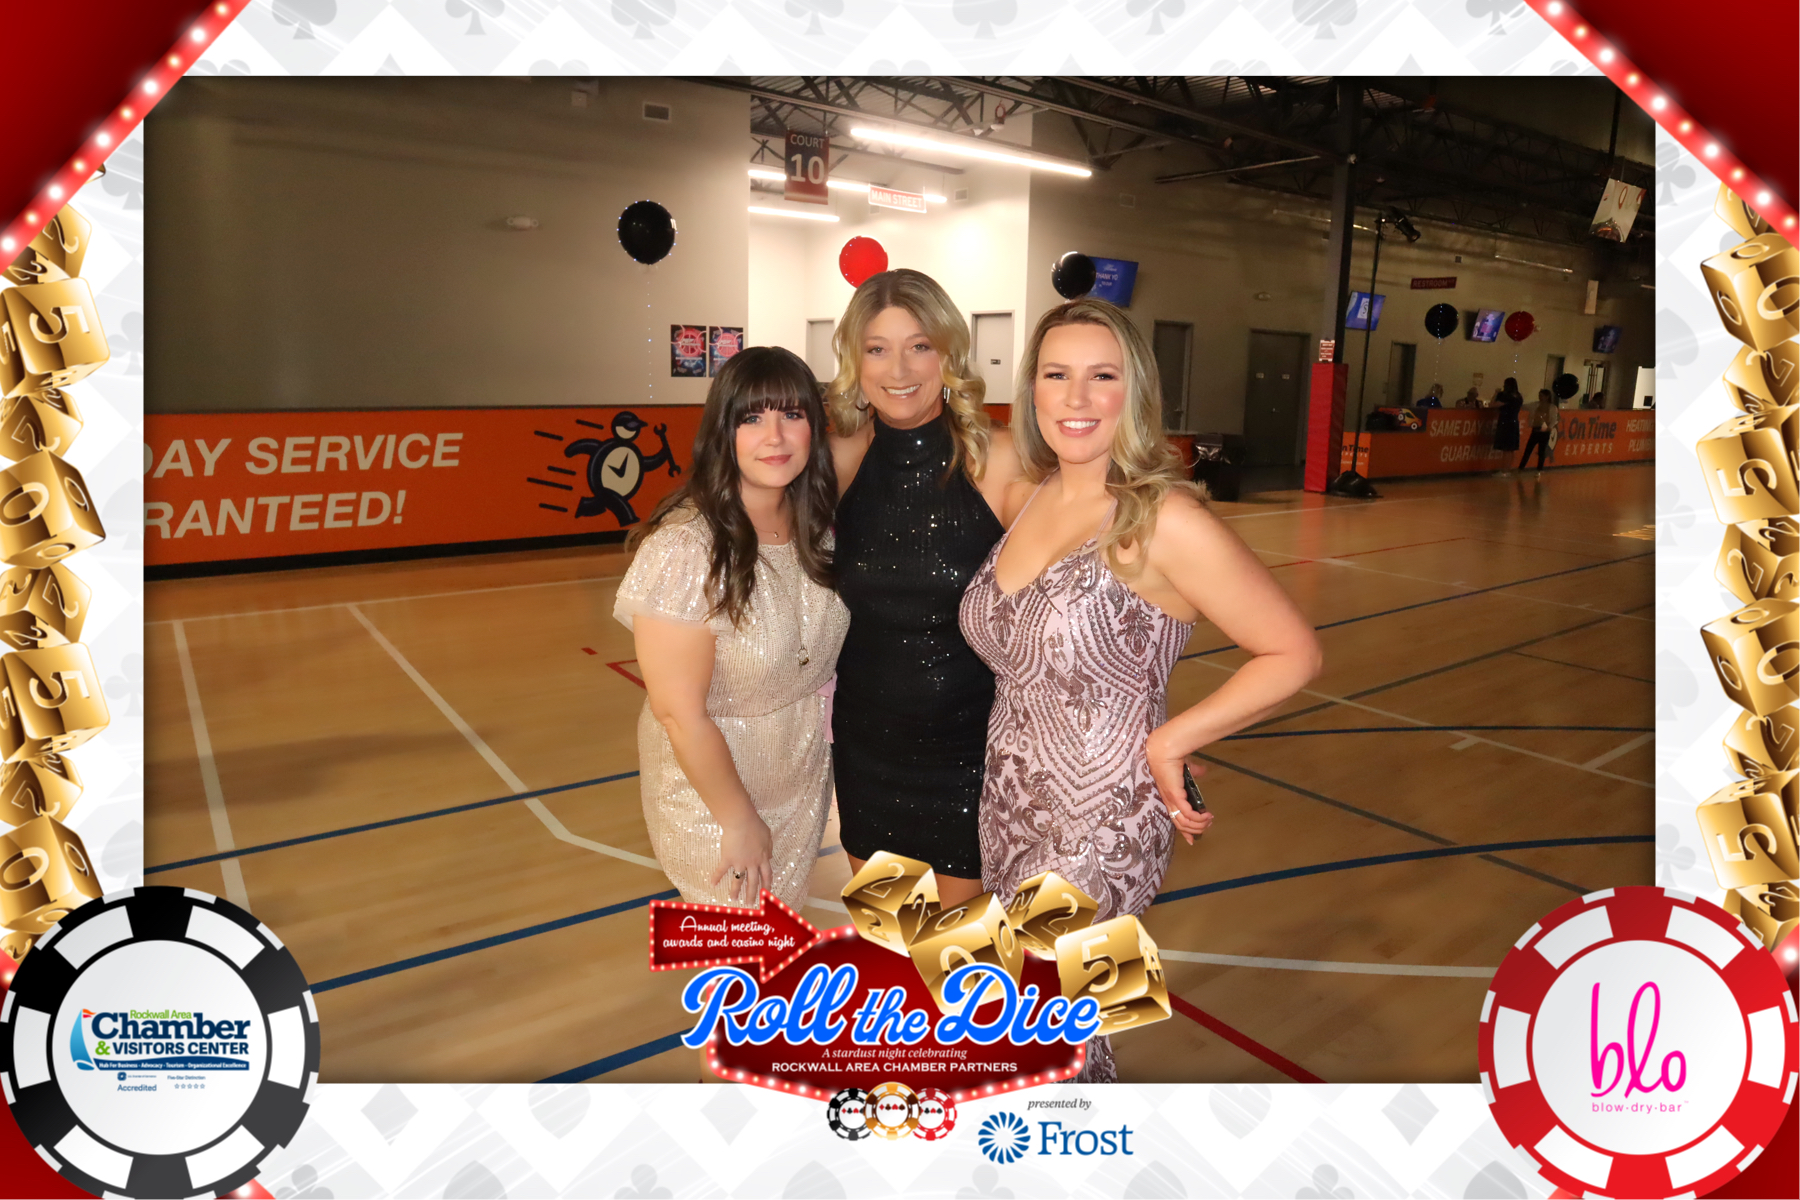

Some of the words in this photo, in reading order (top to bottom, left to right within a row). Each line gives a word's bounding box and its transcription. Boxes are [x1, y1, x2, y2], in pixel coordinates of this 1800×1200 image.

[790, 133, 825, 149] COURT
[790, 153, 825, 185] 10
[871, 189, 891, 203] MAIN
[892, 193, 923, 208] STREET
[1430, 419, 1462, 437] SAME
[1462, 419, 1482, 436] DAY
[1568, 417, 1586, 440] On
[1588, 415, 1617, 441] Time
[144, 438, 232, 479] AY
[245, 432, 464, 475] SERVICE
[1564, 442, 1613, 456] EXPERTS
[144, 489, 406, 539] RANTEED!
